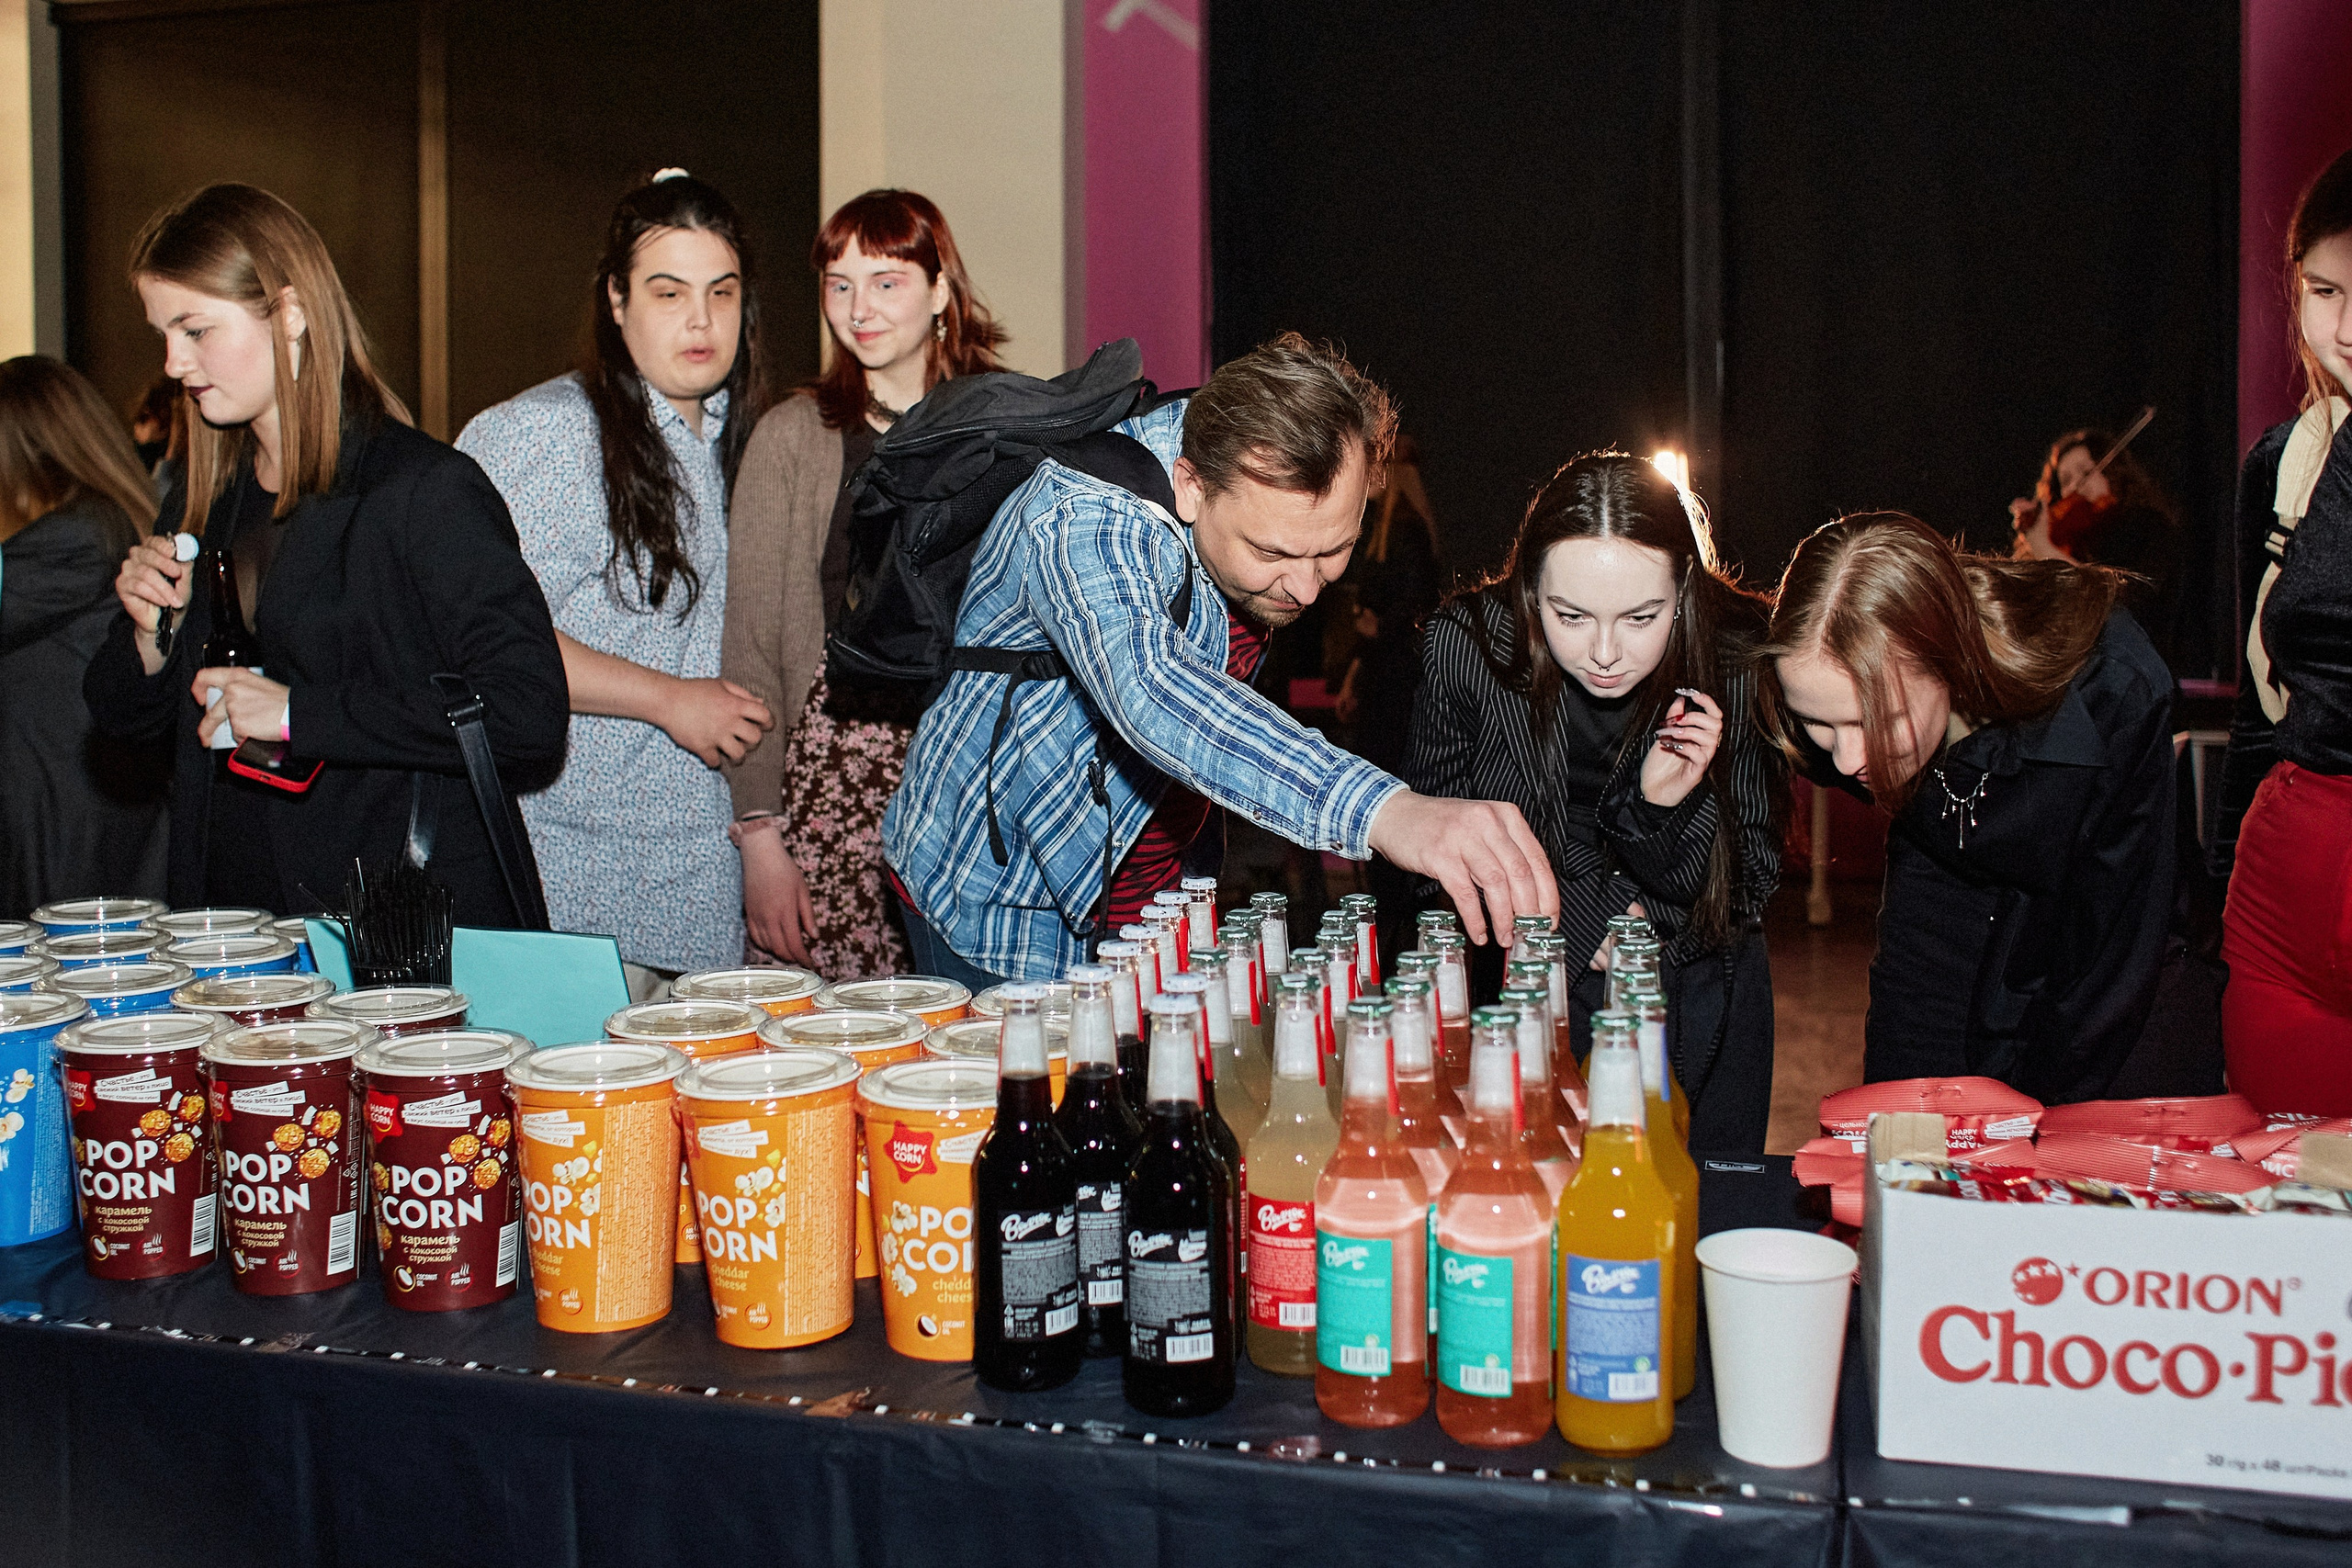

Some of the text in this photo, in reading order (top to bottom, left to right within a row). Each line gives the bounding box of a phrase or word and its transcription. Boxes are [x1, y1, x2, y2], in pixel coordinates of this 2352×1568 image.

[369, 1104, 394, 1116] HAPPY
[370, 1112, 391, 1124] CORN
[86, 1139, 159, 1169] POP
[893, 1141, 927, 1155] HAPPY
[893, 1152, 922, 1164] CORN
[225, 1150, 292, 1182] POP
[80, 1168, 175, 1201] CORN
[392, 1165, 468, 1197] POP
[221, 1179, 311, 1214] CORN
[96, 1205, 153, 1217] карамель
[382, 1194, 483, 1229] CORN
[697, 1190, 758, 1228] POP
[104, 1216, 150, 1224] кокосовой
[234, 1218, 287, 1231] карамель
[921, 1206, 973, 1239] PO
[103, 1224, 144, 1234] стружкой
[527, 1212, 592, 1249] ORN
[243, 1232, 285, 1240] кокосовой
[401, 1235, 460, 1247] карамель
[242, 1238, 279, 1248] стружкой
[704, 1226, 778, 1262] ORN
[410, 1247, 458, 1255] кокосовой
[903, 1238, 974, 1274] CO
[409, 1254, 452, 1264] стружкой
[715, 1275, 747, 1292] cheese
[933, 1278, 971, 1291] chedd
[937, 1292, 972, 1303] chees
[1918, 1304, 2352, 1408] Choco·Pi
